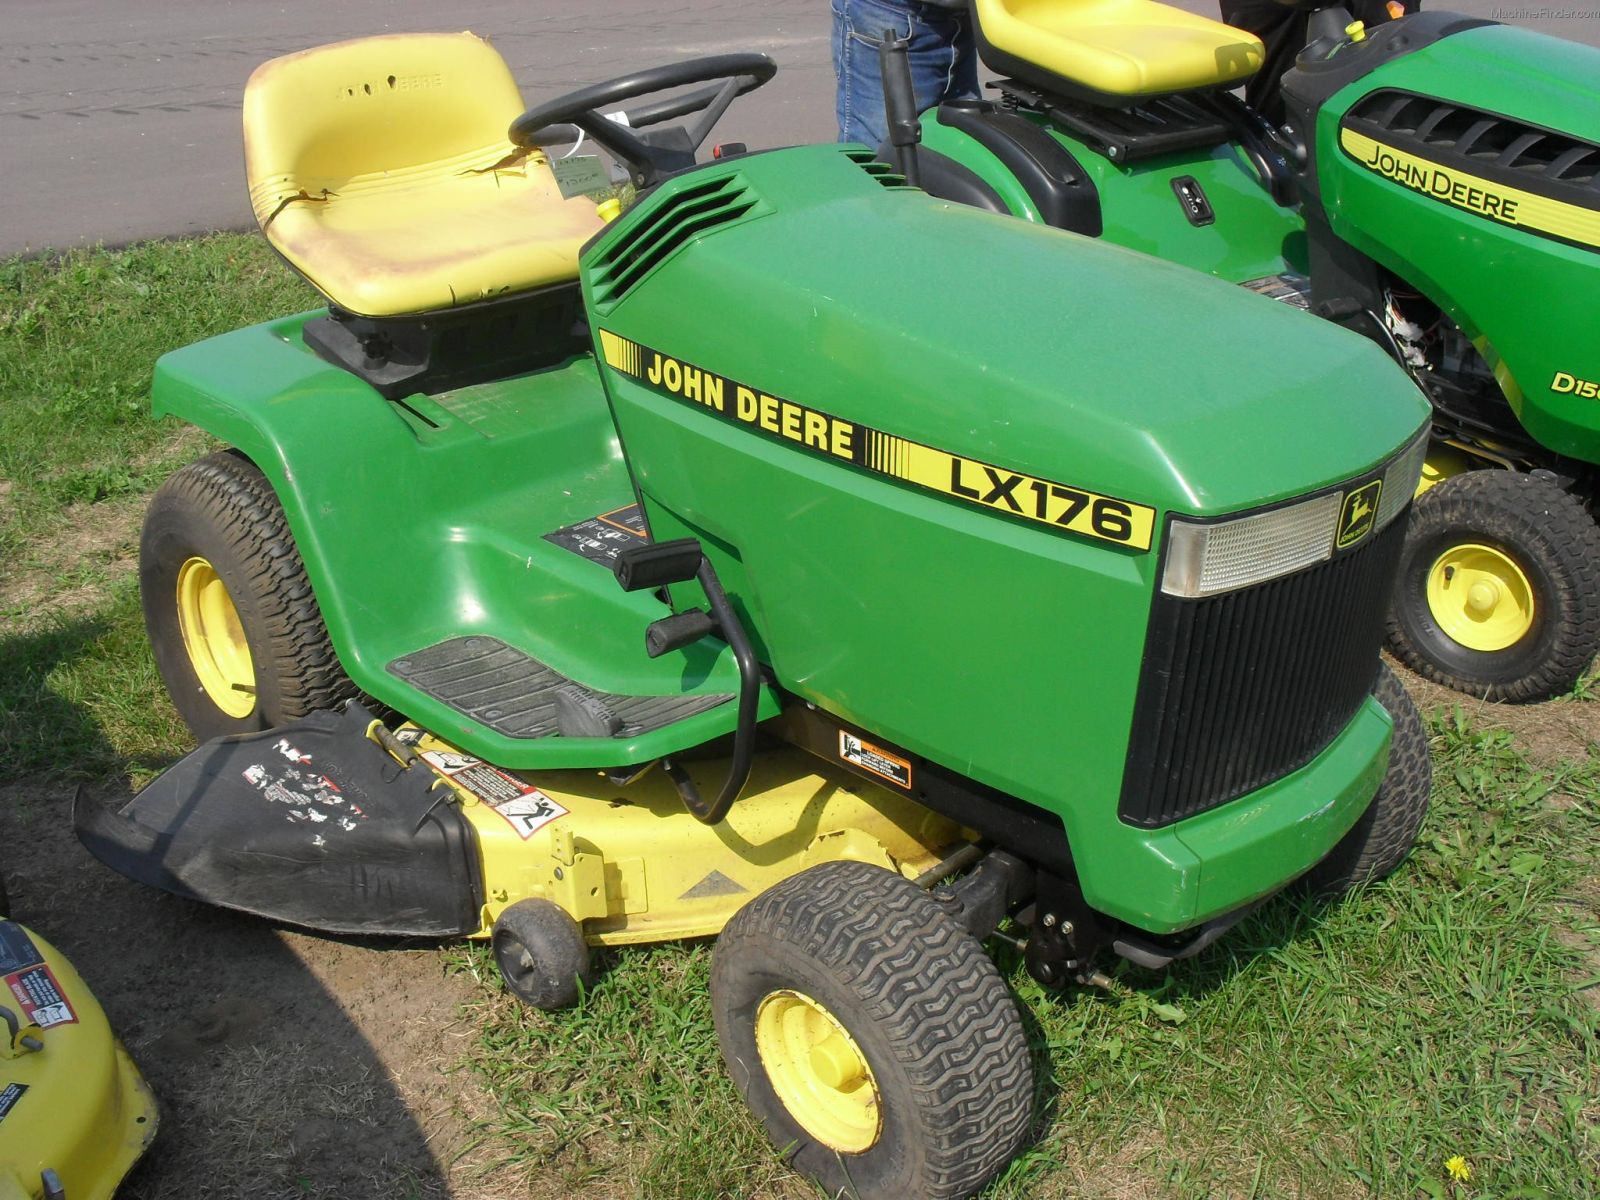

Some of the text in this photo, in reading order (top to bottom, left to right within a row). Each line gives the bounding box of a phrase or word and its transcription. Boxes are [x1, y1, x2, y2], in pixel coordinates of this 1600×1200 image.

[1367, 145, 1519, 221] JOHN DEERE
[648, 354, 853, 460] JOHN DEERE
[1550, 371, 1600, 400] D15
[951, 457, 1133, 541] LX176
